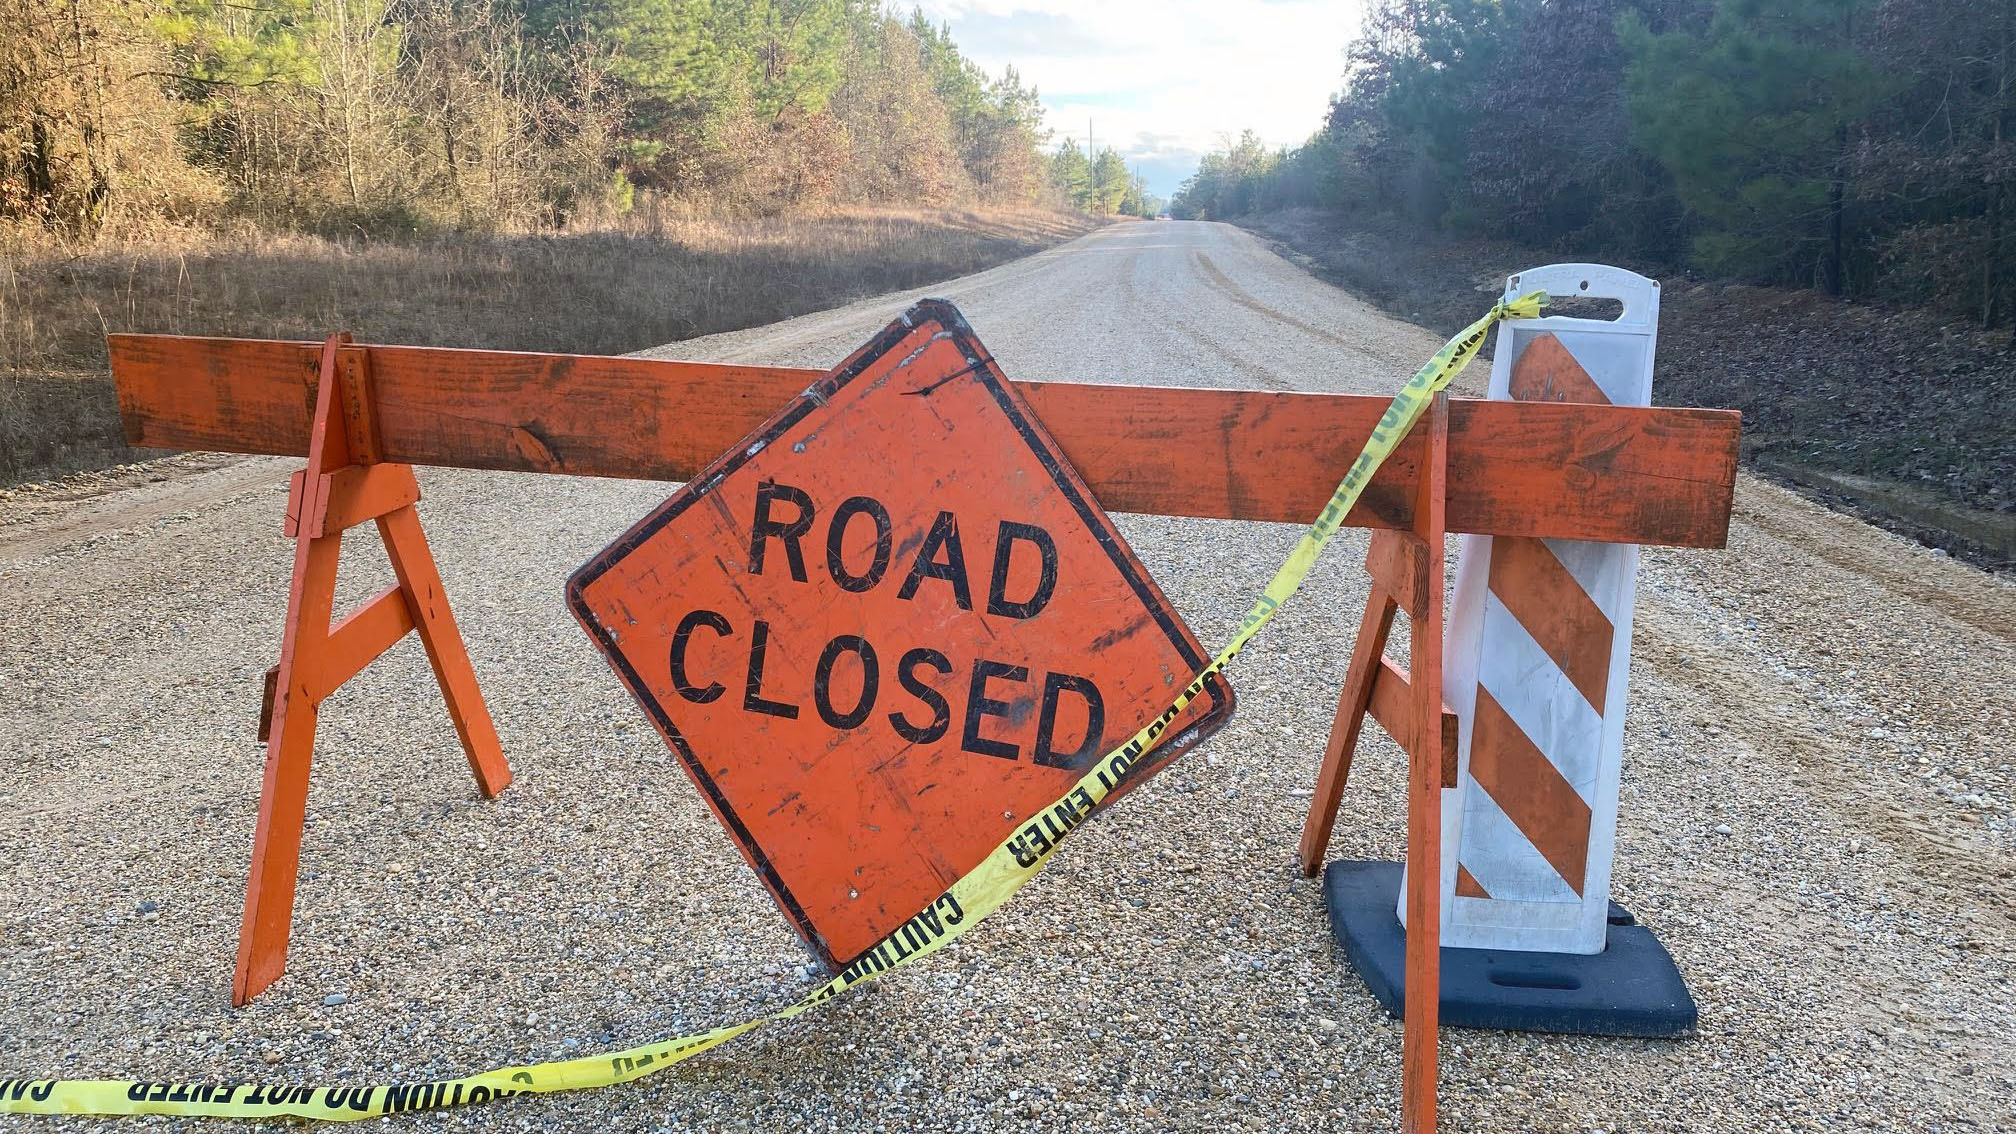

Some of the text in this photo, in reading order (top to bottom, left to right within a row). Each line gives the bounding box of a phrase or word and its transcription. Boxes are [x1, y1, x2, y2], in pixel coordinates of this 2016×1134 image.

[748, 480, 1059, 620] ROAD
[668, 609, 1105, 770] CLOSED
[1006, 786, 1097, 868] ENTER
[842, 891, 964, 987] CAUTION
[127, 1082, 239, 1104] ENTER
[325, 1088, 375, 1112] DO
[382, 1083, 535, 1113] UTION
